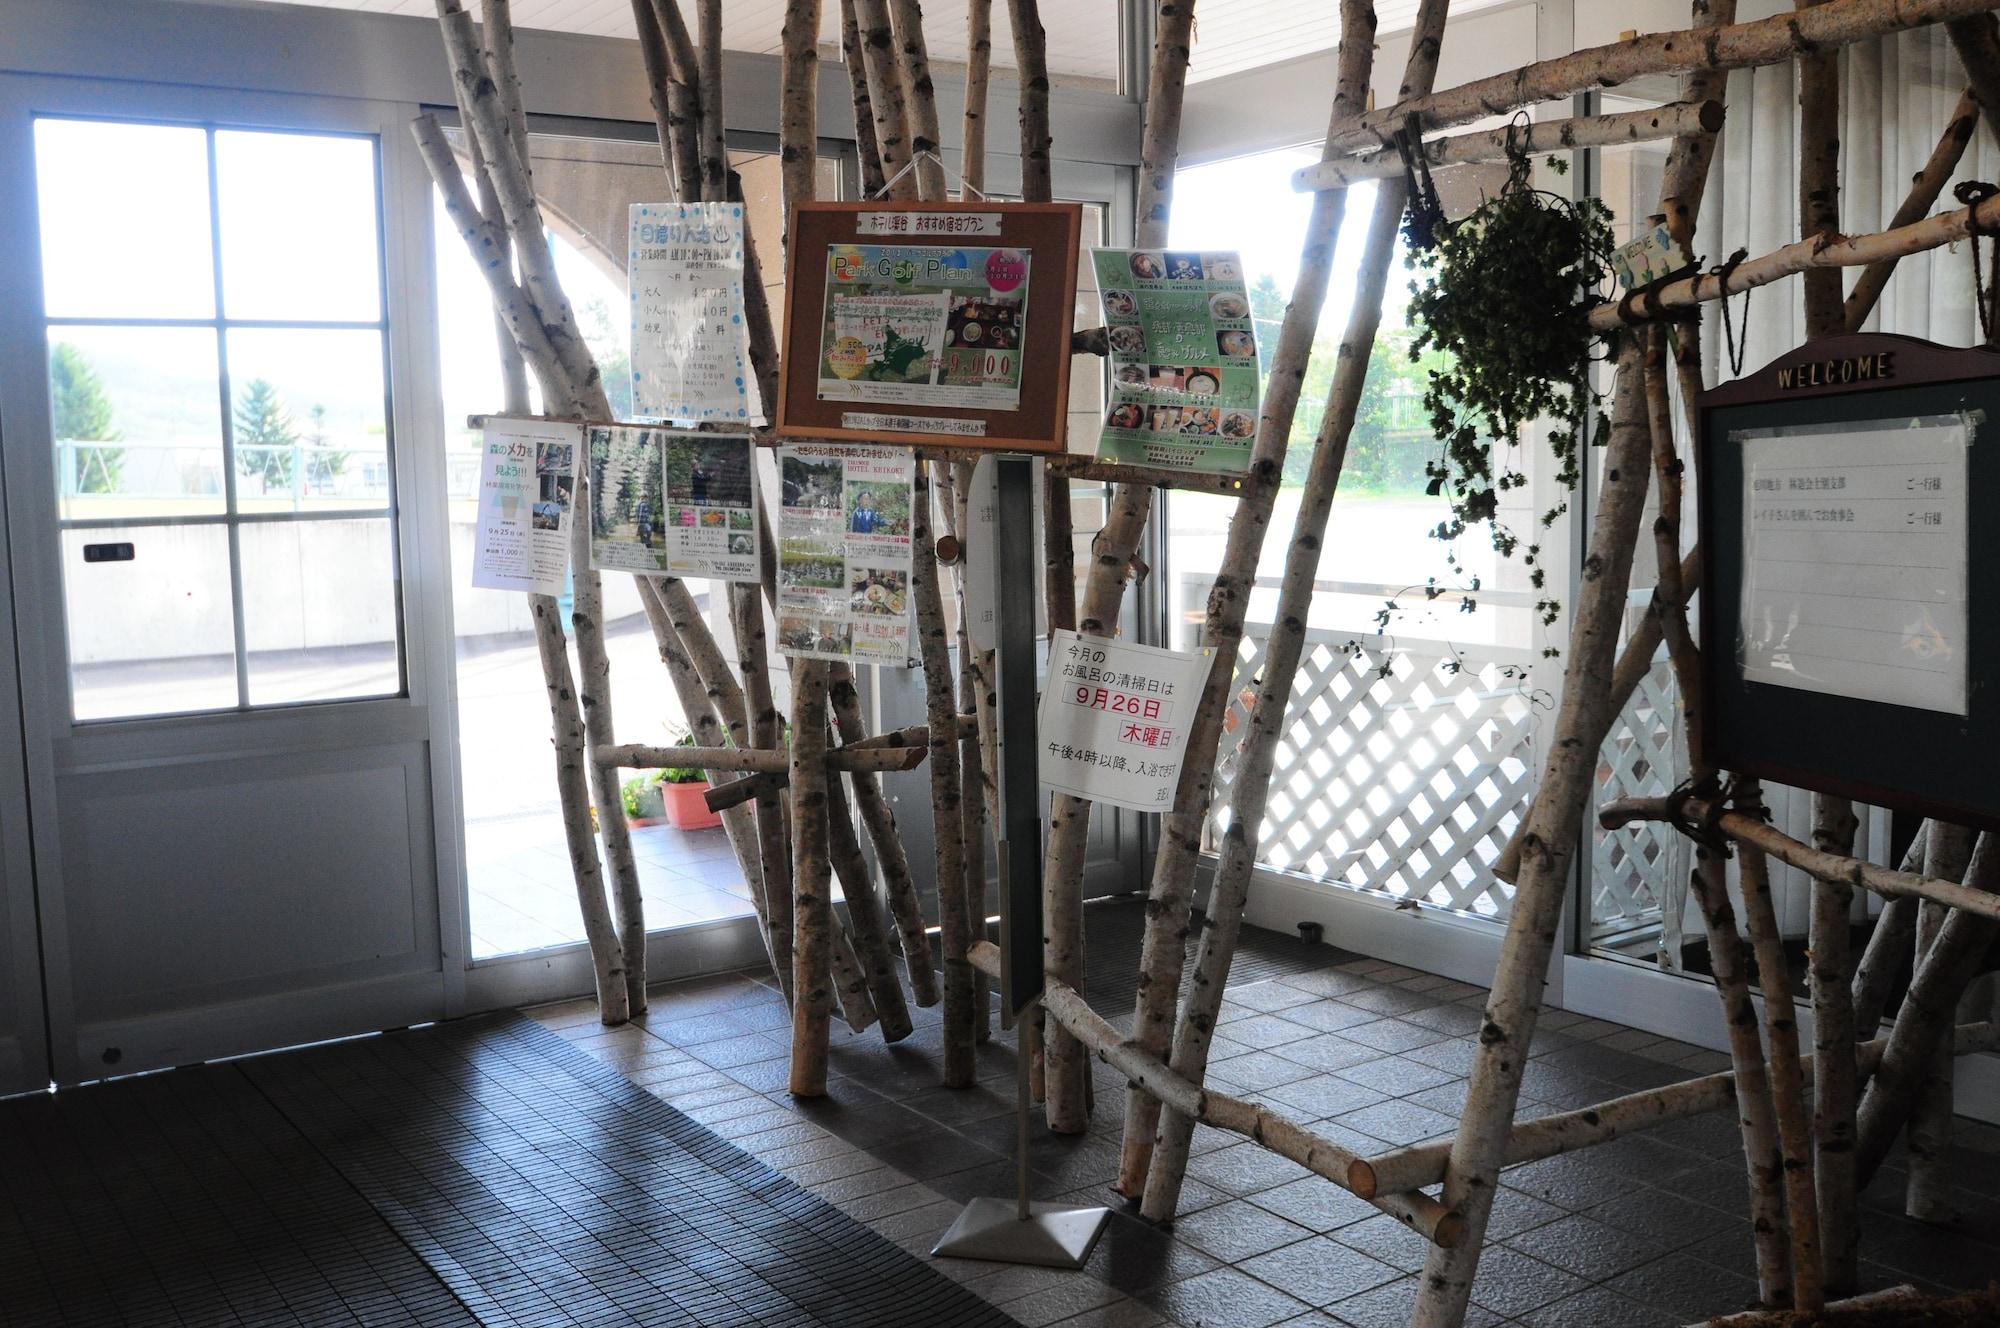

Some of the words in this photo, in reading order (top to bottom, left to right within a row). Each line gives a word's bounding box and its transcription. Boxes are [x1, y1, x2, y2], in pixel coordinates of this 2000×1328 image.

[870, 216, 909, 230] ホテル渓谷
[916, 216, 985, 233] おすすめ宿泊プラン
[834, 257, 875, 277] Park
[878, 258, 923, 279] Golf
[927, 259, 973, 281] Plan
[644, 286, 661, 297] 大人
[1778, 353, 1888, 389] WELCOME
[490, 443, 534, 458] 森のメカを
[1907, 477, 1942, 491] ご一行様
[1907, 511, 1942, 525] ご一行様
[1067, 645, 1106, 663] 今月の
[1062, 663, 1175, 696] お風呂の清掃日は
[1076, 687, 1161, 720] 9月26日
[1123, 723, 1172, 748] 木曜日
